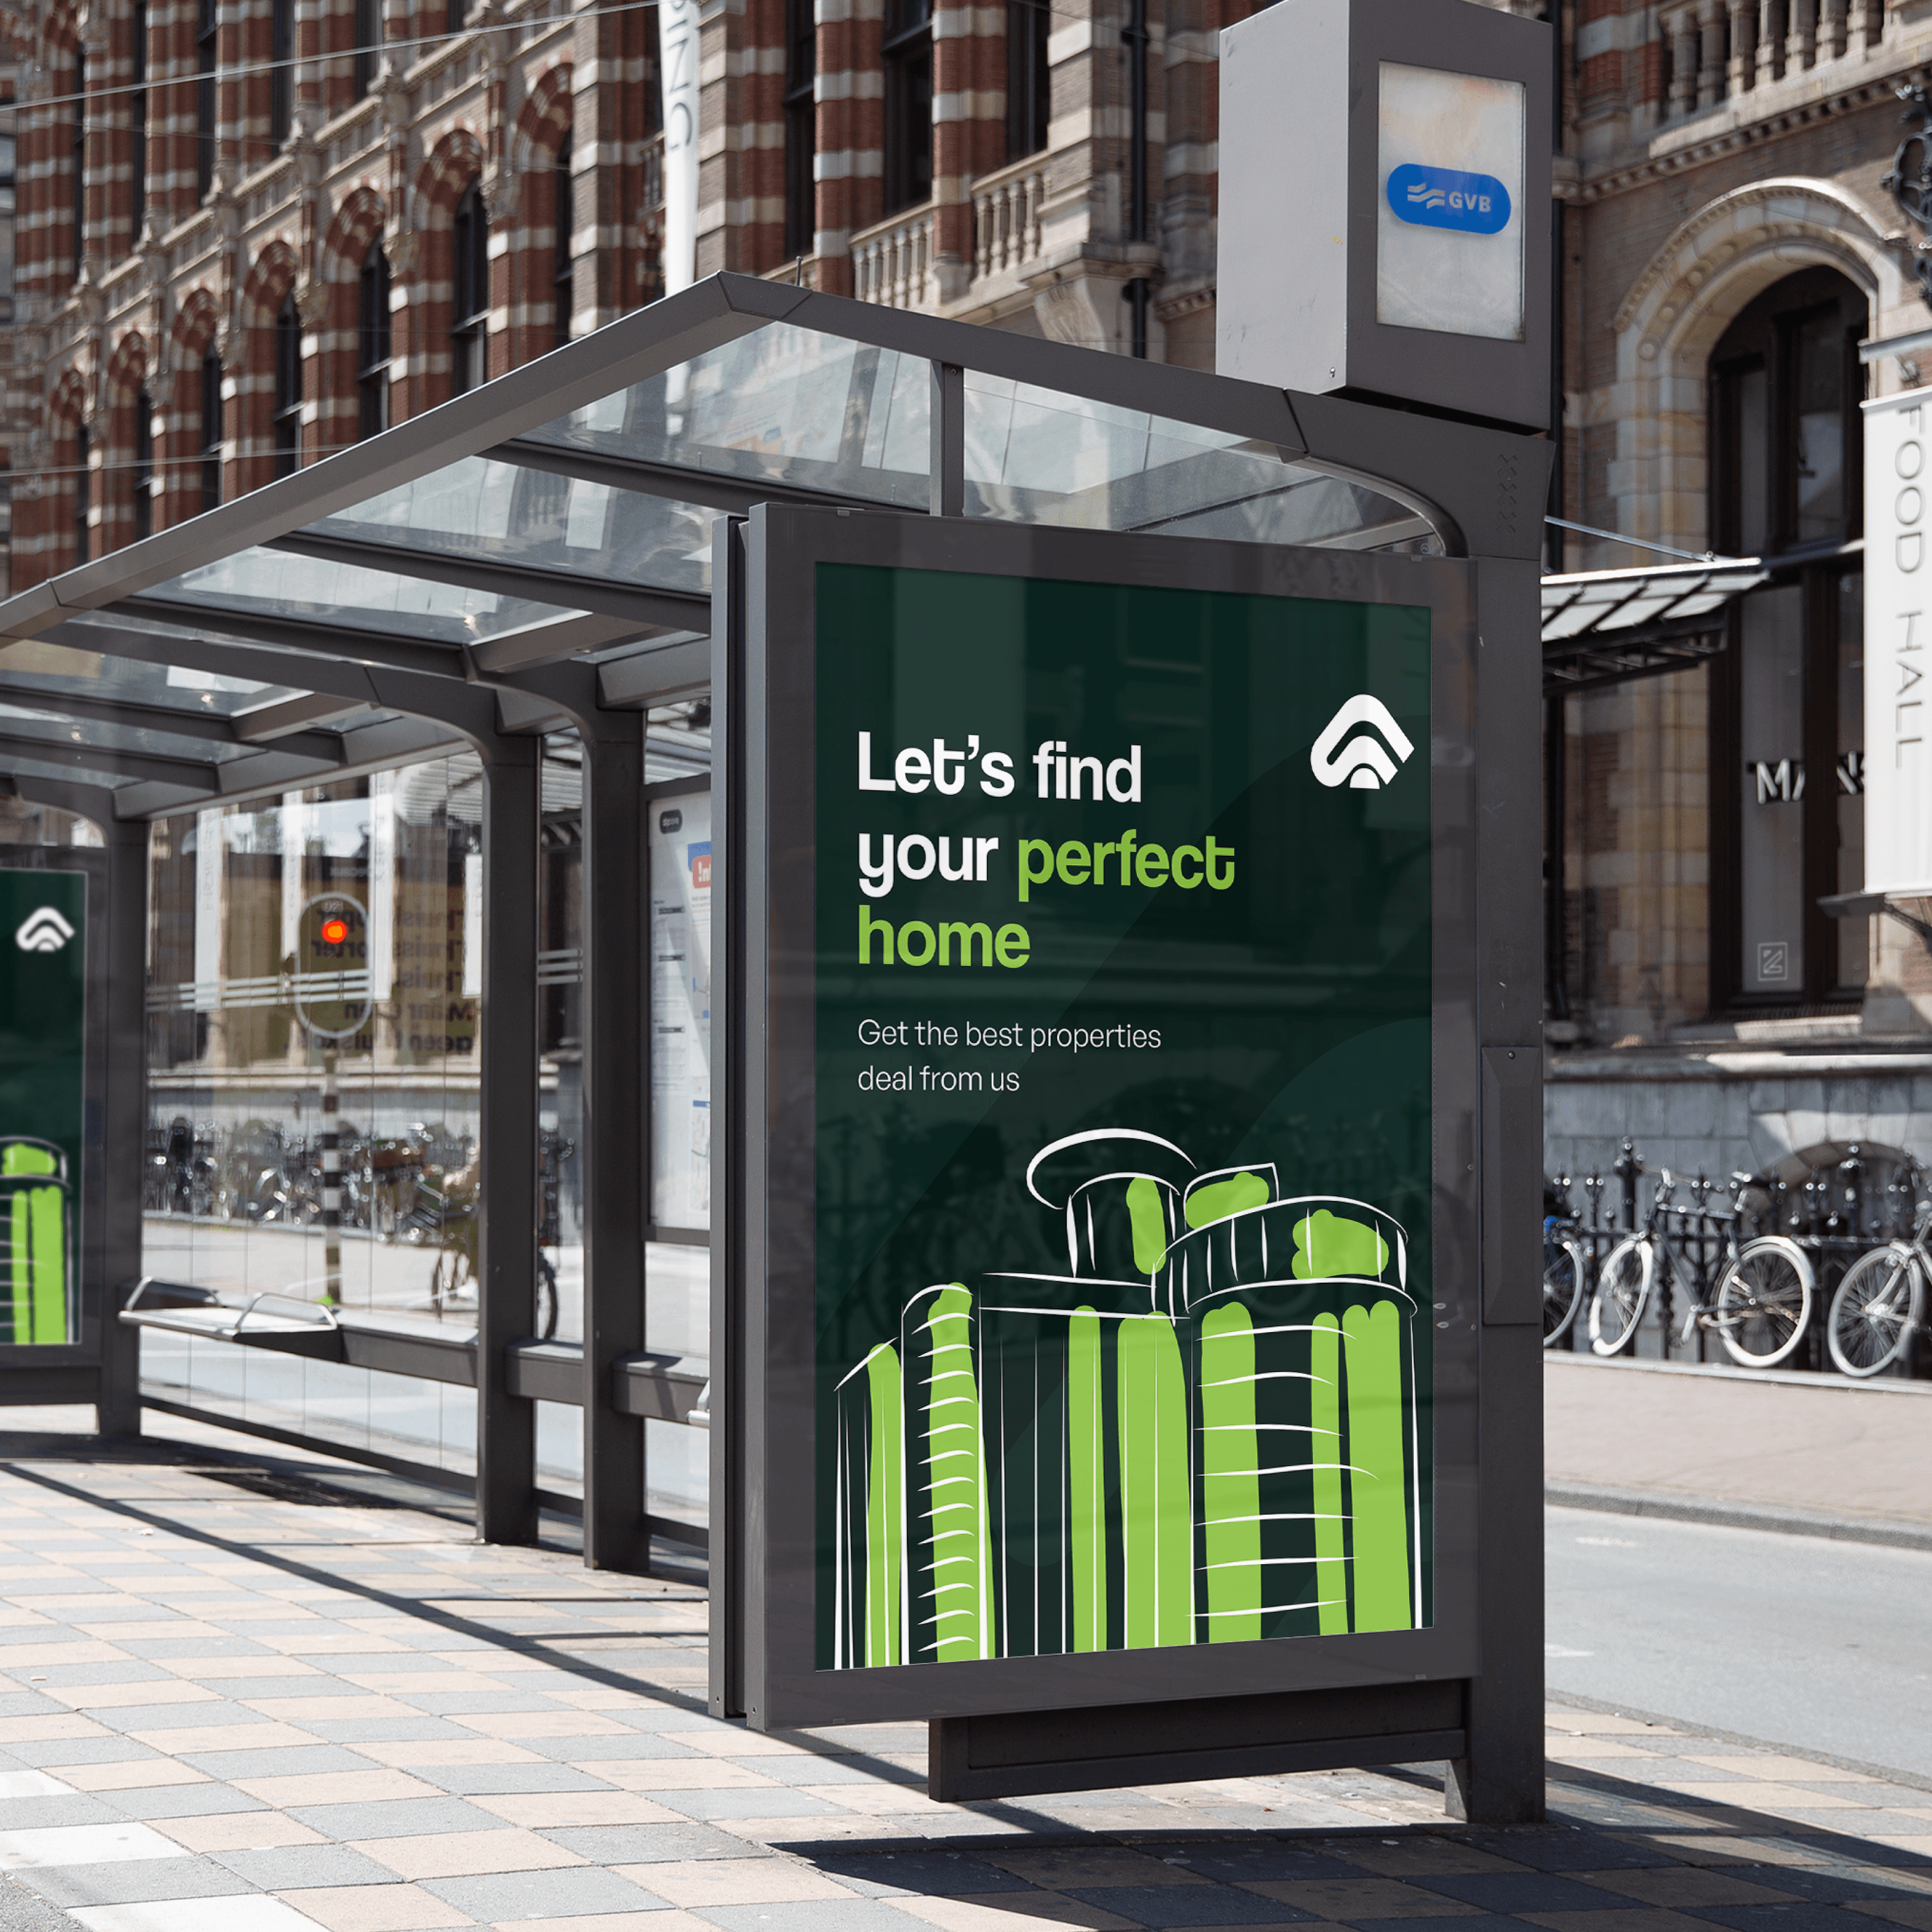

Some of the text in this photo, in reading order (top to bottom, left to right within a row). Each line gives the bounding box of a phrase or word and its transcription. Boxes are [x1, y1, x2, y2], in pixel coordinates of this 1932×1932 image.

[1448, 191, 1491, 212] GVB
[1895, 404, 1925, 769] FOOD HALL
[858, 730, 1142, 803] Let’s find
[859, 828, 1235, 903] your perfect
[859, 905, 1030, 968] home
[857, 1018, 1162, 1053] Get the best properties
[857, 1065, 1020, 1091] deal from us
